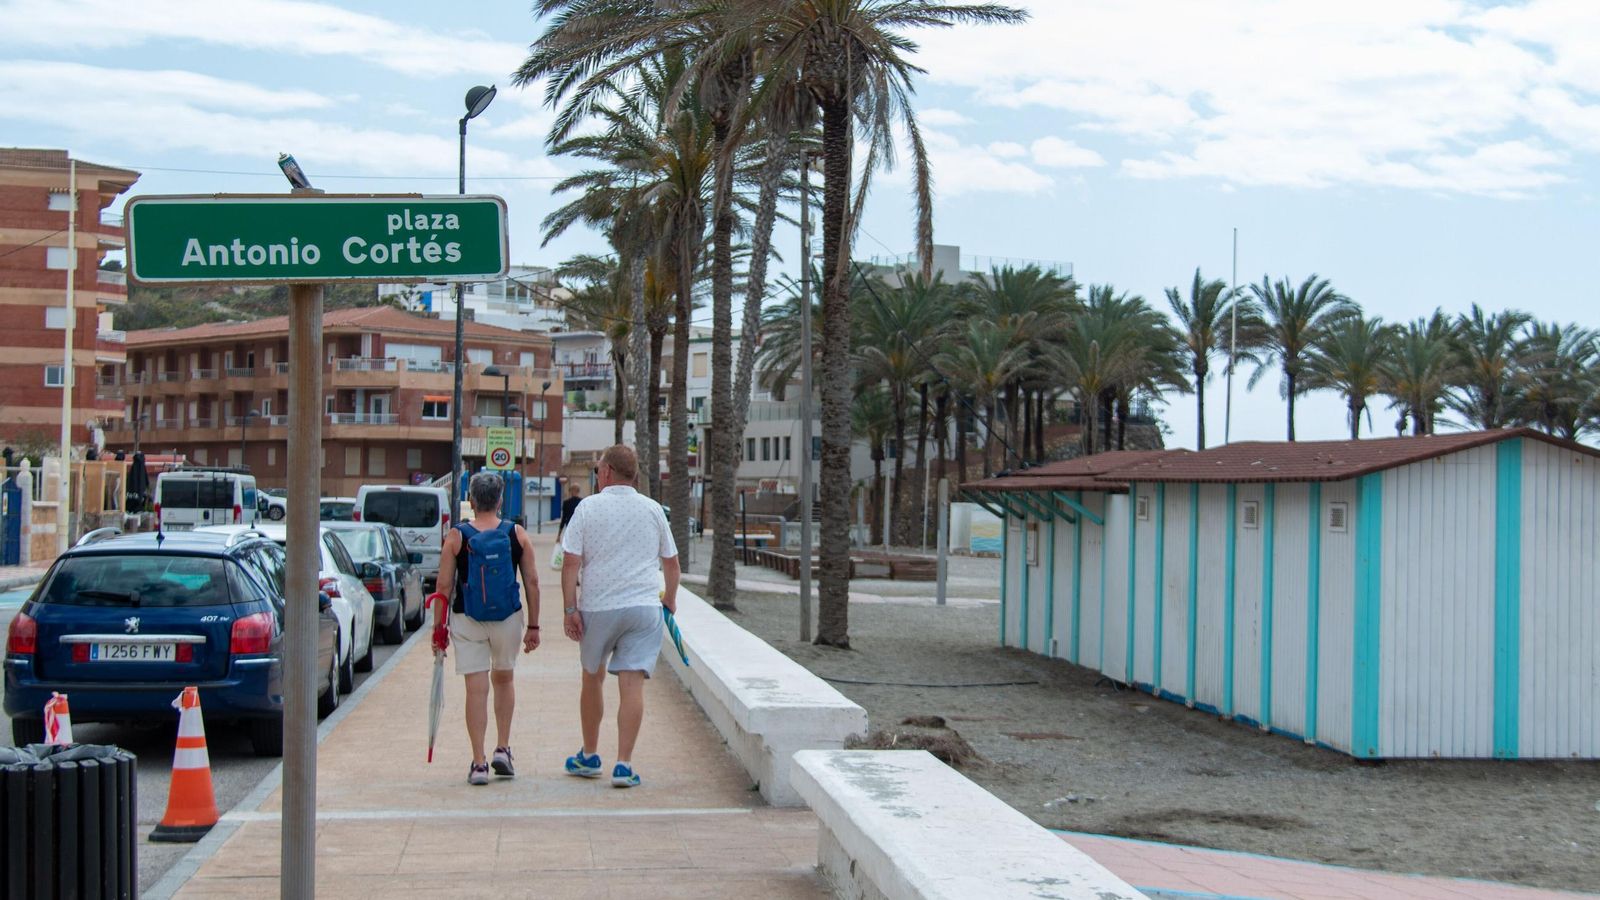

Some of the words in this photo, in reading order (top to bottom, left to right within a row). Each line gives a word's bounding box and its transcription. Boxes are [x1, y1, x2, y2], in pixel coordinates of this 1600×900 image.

[387, 208, 460, 236] plaza
[181, 236, 321, 266] Antonio
[342, 233, 462, 265] Cortés
[494, 452, 507, 461] 20
[103, 644, 138, 659] 1256
[143, 644, 171, 659] FWY
